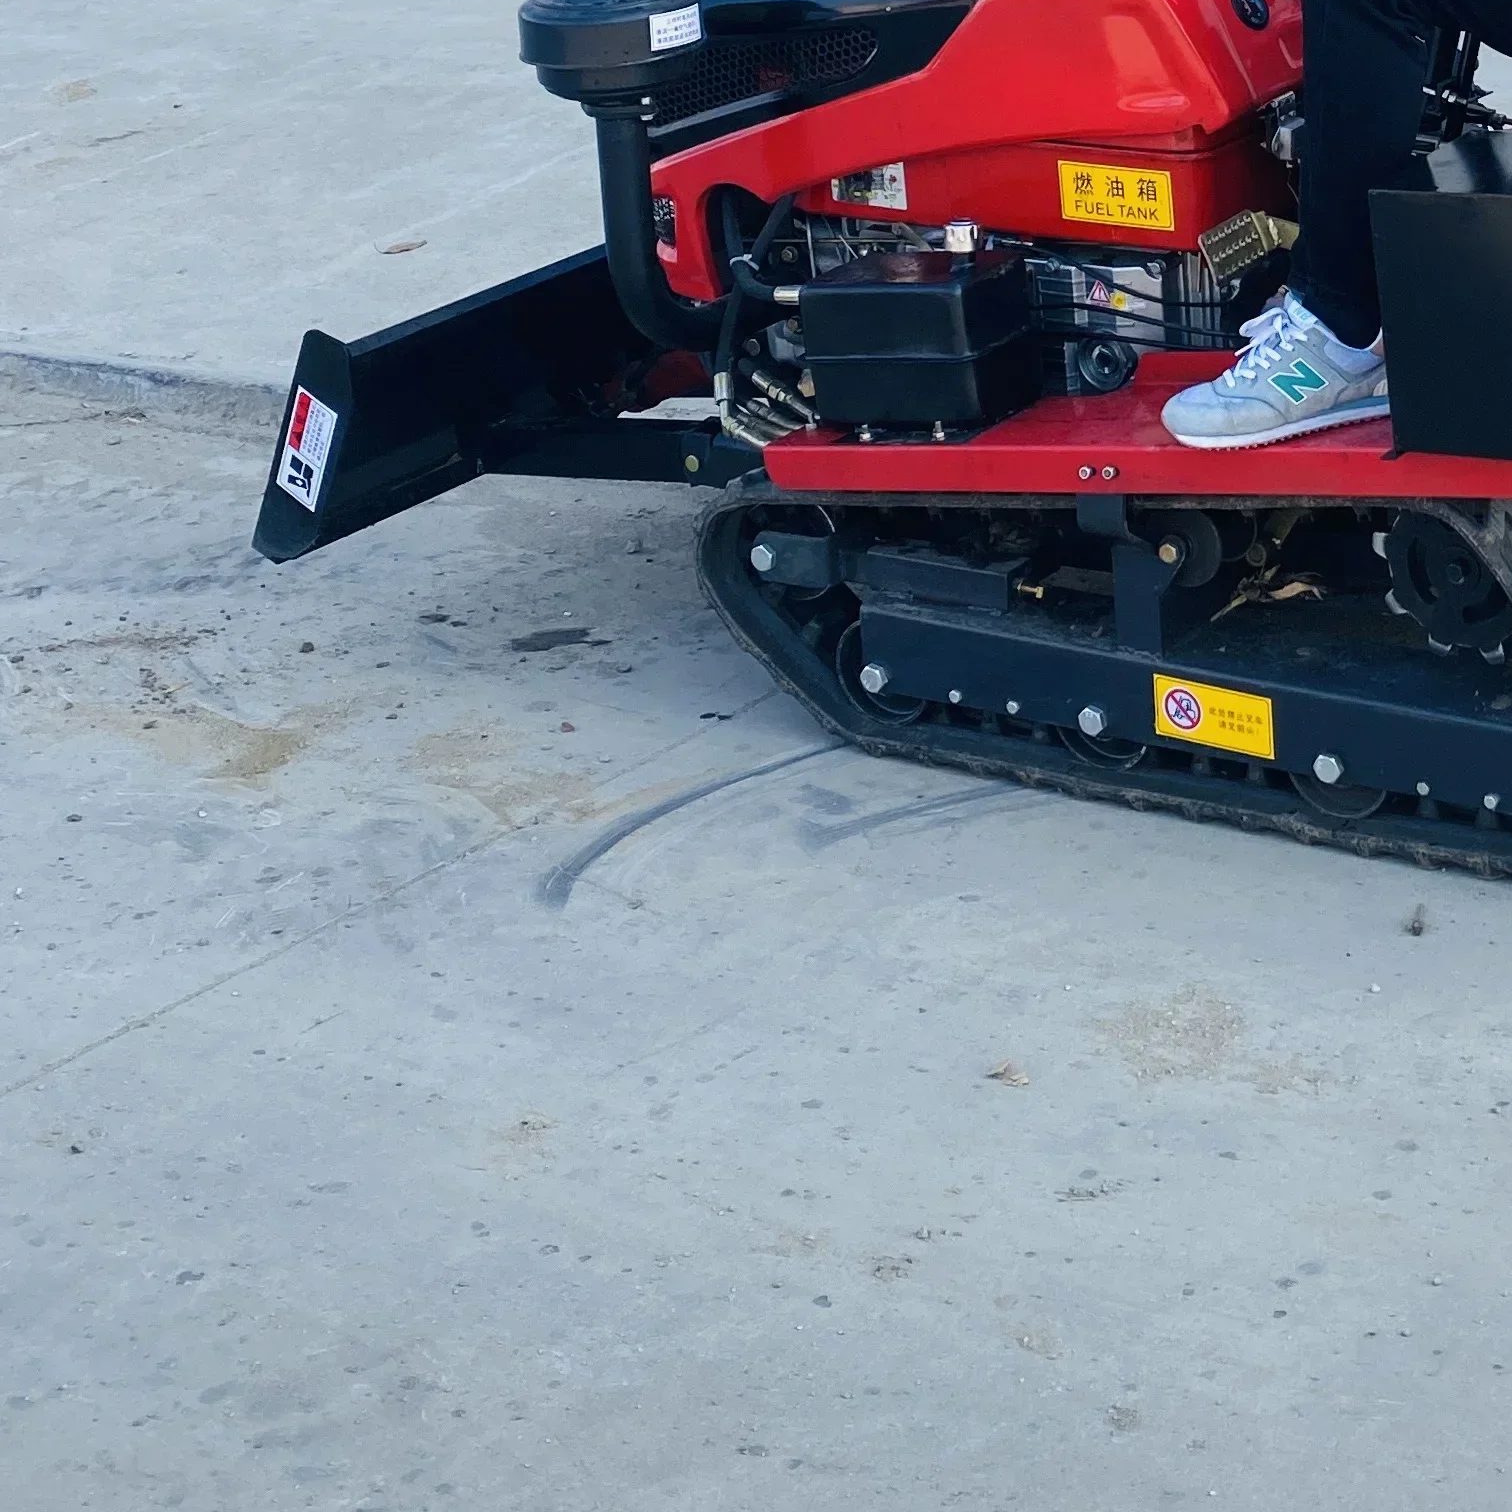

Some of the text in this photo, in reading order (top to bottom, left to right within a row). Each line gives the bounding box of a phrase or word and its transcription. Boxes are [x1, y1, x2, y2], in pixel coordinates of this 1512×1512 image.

[1073, 171, 1157, 202] 燃油箱
[1074, 199, 1160, 222] FUEL TANK
[1267, 357, 1329, 405] N
